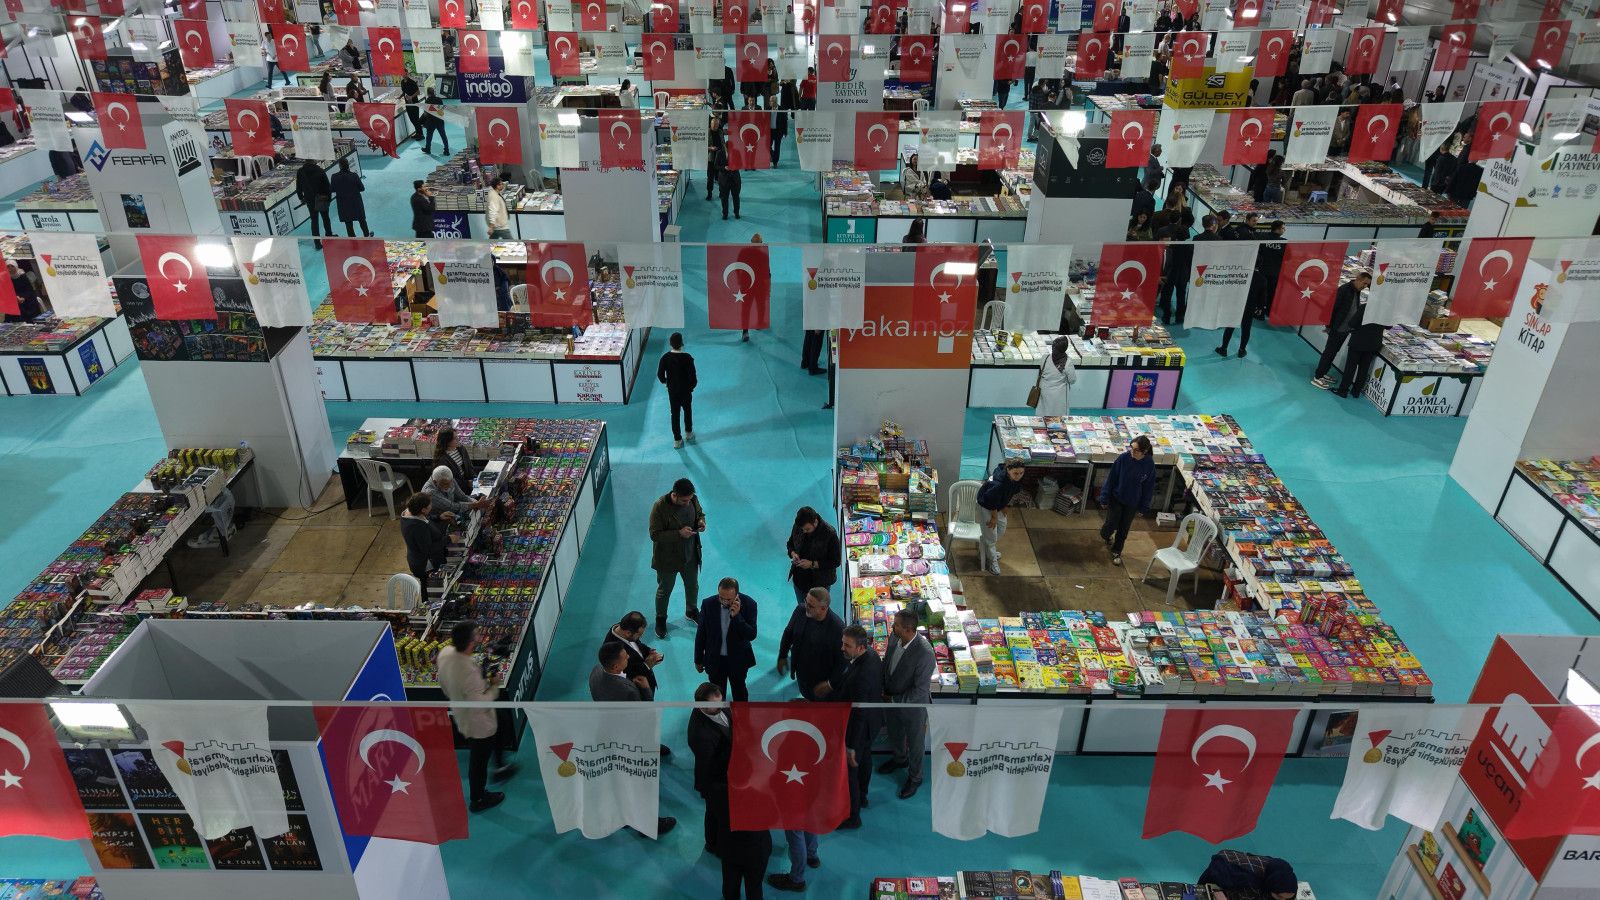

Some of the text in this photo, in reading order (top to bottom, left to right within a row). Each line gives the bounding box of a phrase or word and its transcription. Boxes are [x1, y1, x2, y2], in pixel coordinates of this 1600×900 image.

[465, 79, 511, 98] indigo
[1183, 90, 1245, 100] GÜLBEY
[1564, 153, 1599, 161] DAMLA
[1494, 162, 1517, 175] DAMLA
[848, 316, 969, 342] yakamoz
[1524, 311, 1551, 336] SİNCAP
[1518, 328, 1545, 354] KİTAP
[1407, 397, 1447, 406] DAMLA
[1403, 404, 1450, 414] YAYINEVİ
[152, 817, 182, 825] HER
